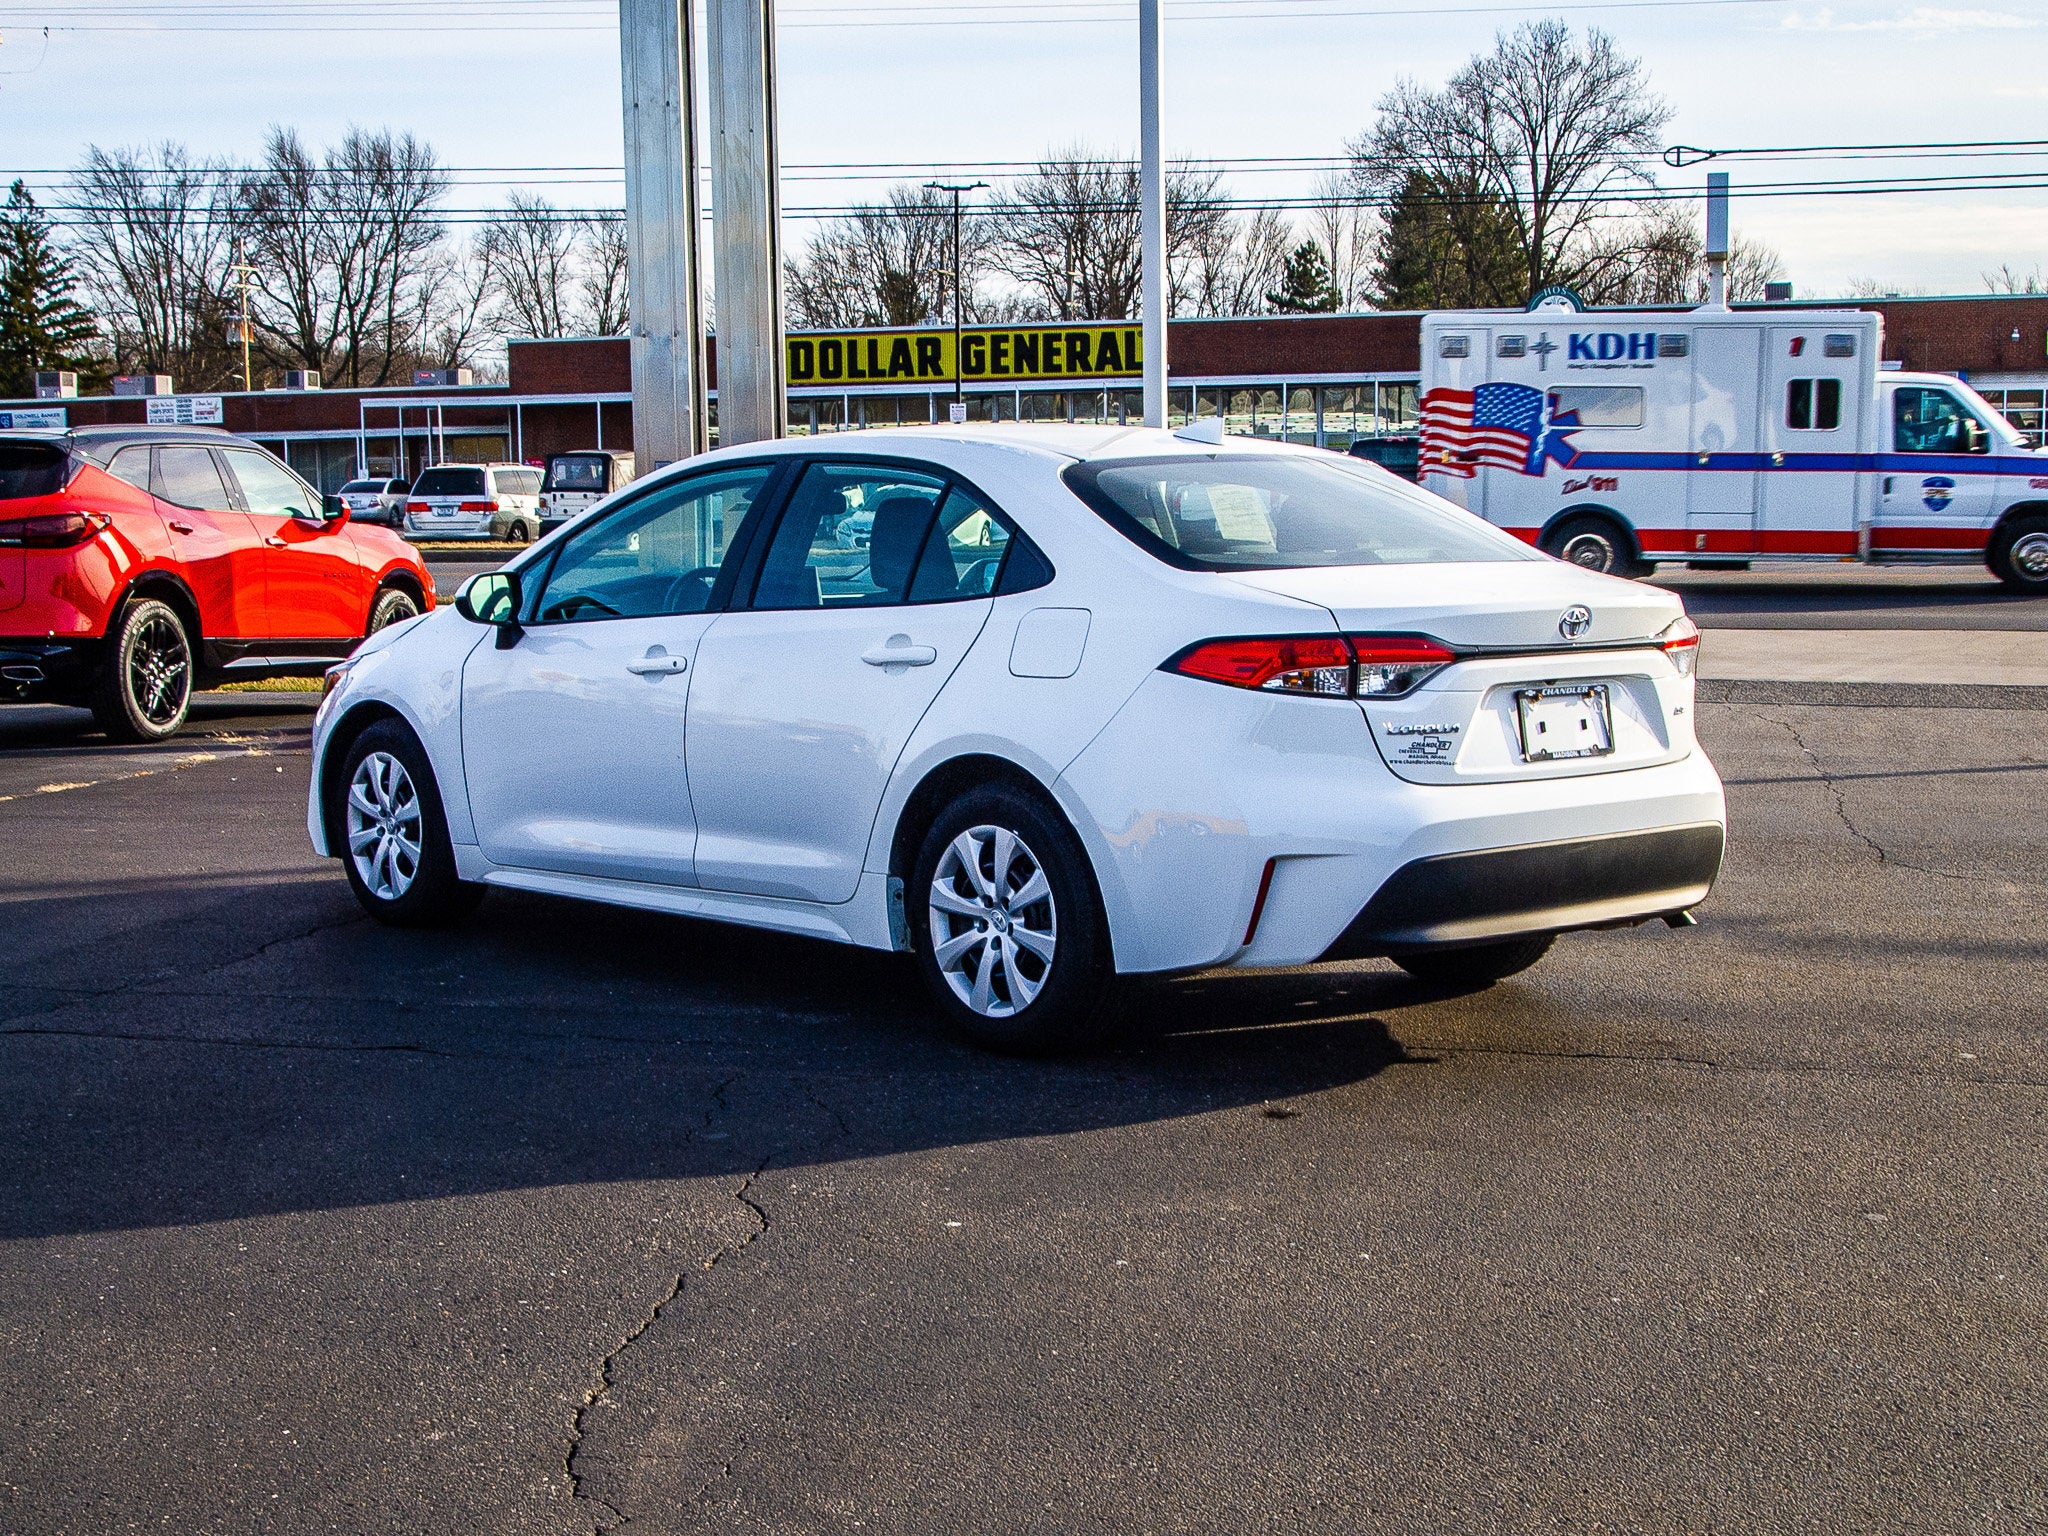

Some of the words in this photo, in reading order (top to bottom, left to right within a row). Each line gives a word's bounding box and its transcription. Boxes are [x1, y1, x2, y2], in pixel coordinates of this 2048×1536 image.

[788, 336, 944, 380] DOLLAR
[960, 330, 1143, 376] GENERAL
[1567, 332, 1656, 360] KDH
[1788, 335, 1807, 357] 1
[1542, 686, 1589, 696] CHANDLER
[1411, 741, 1448, 749] CHANDLER
